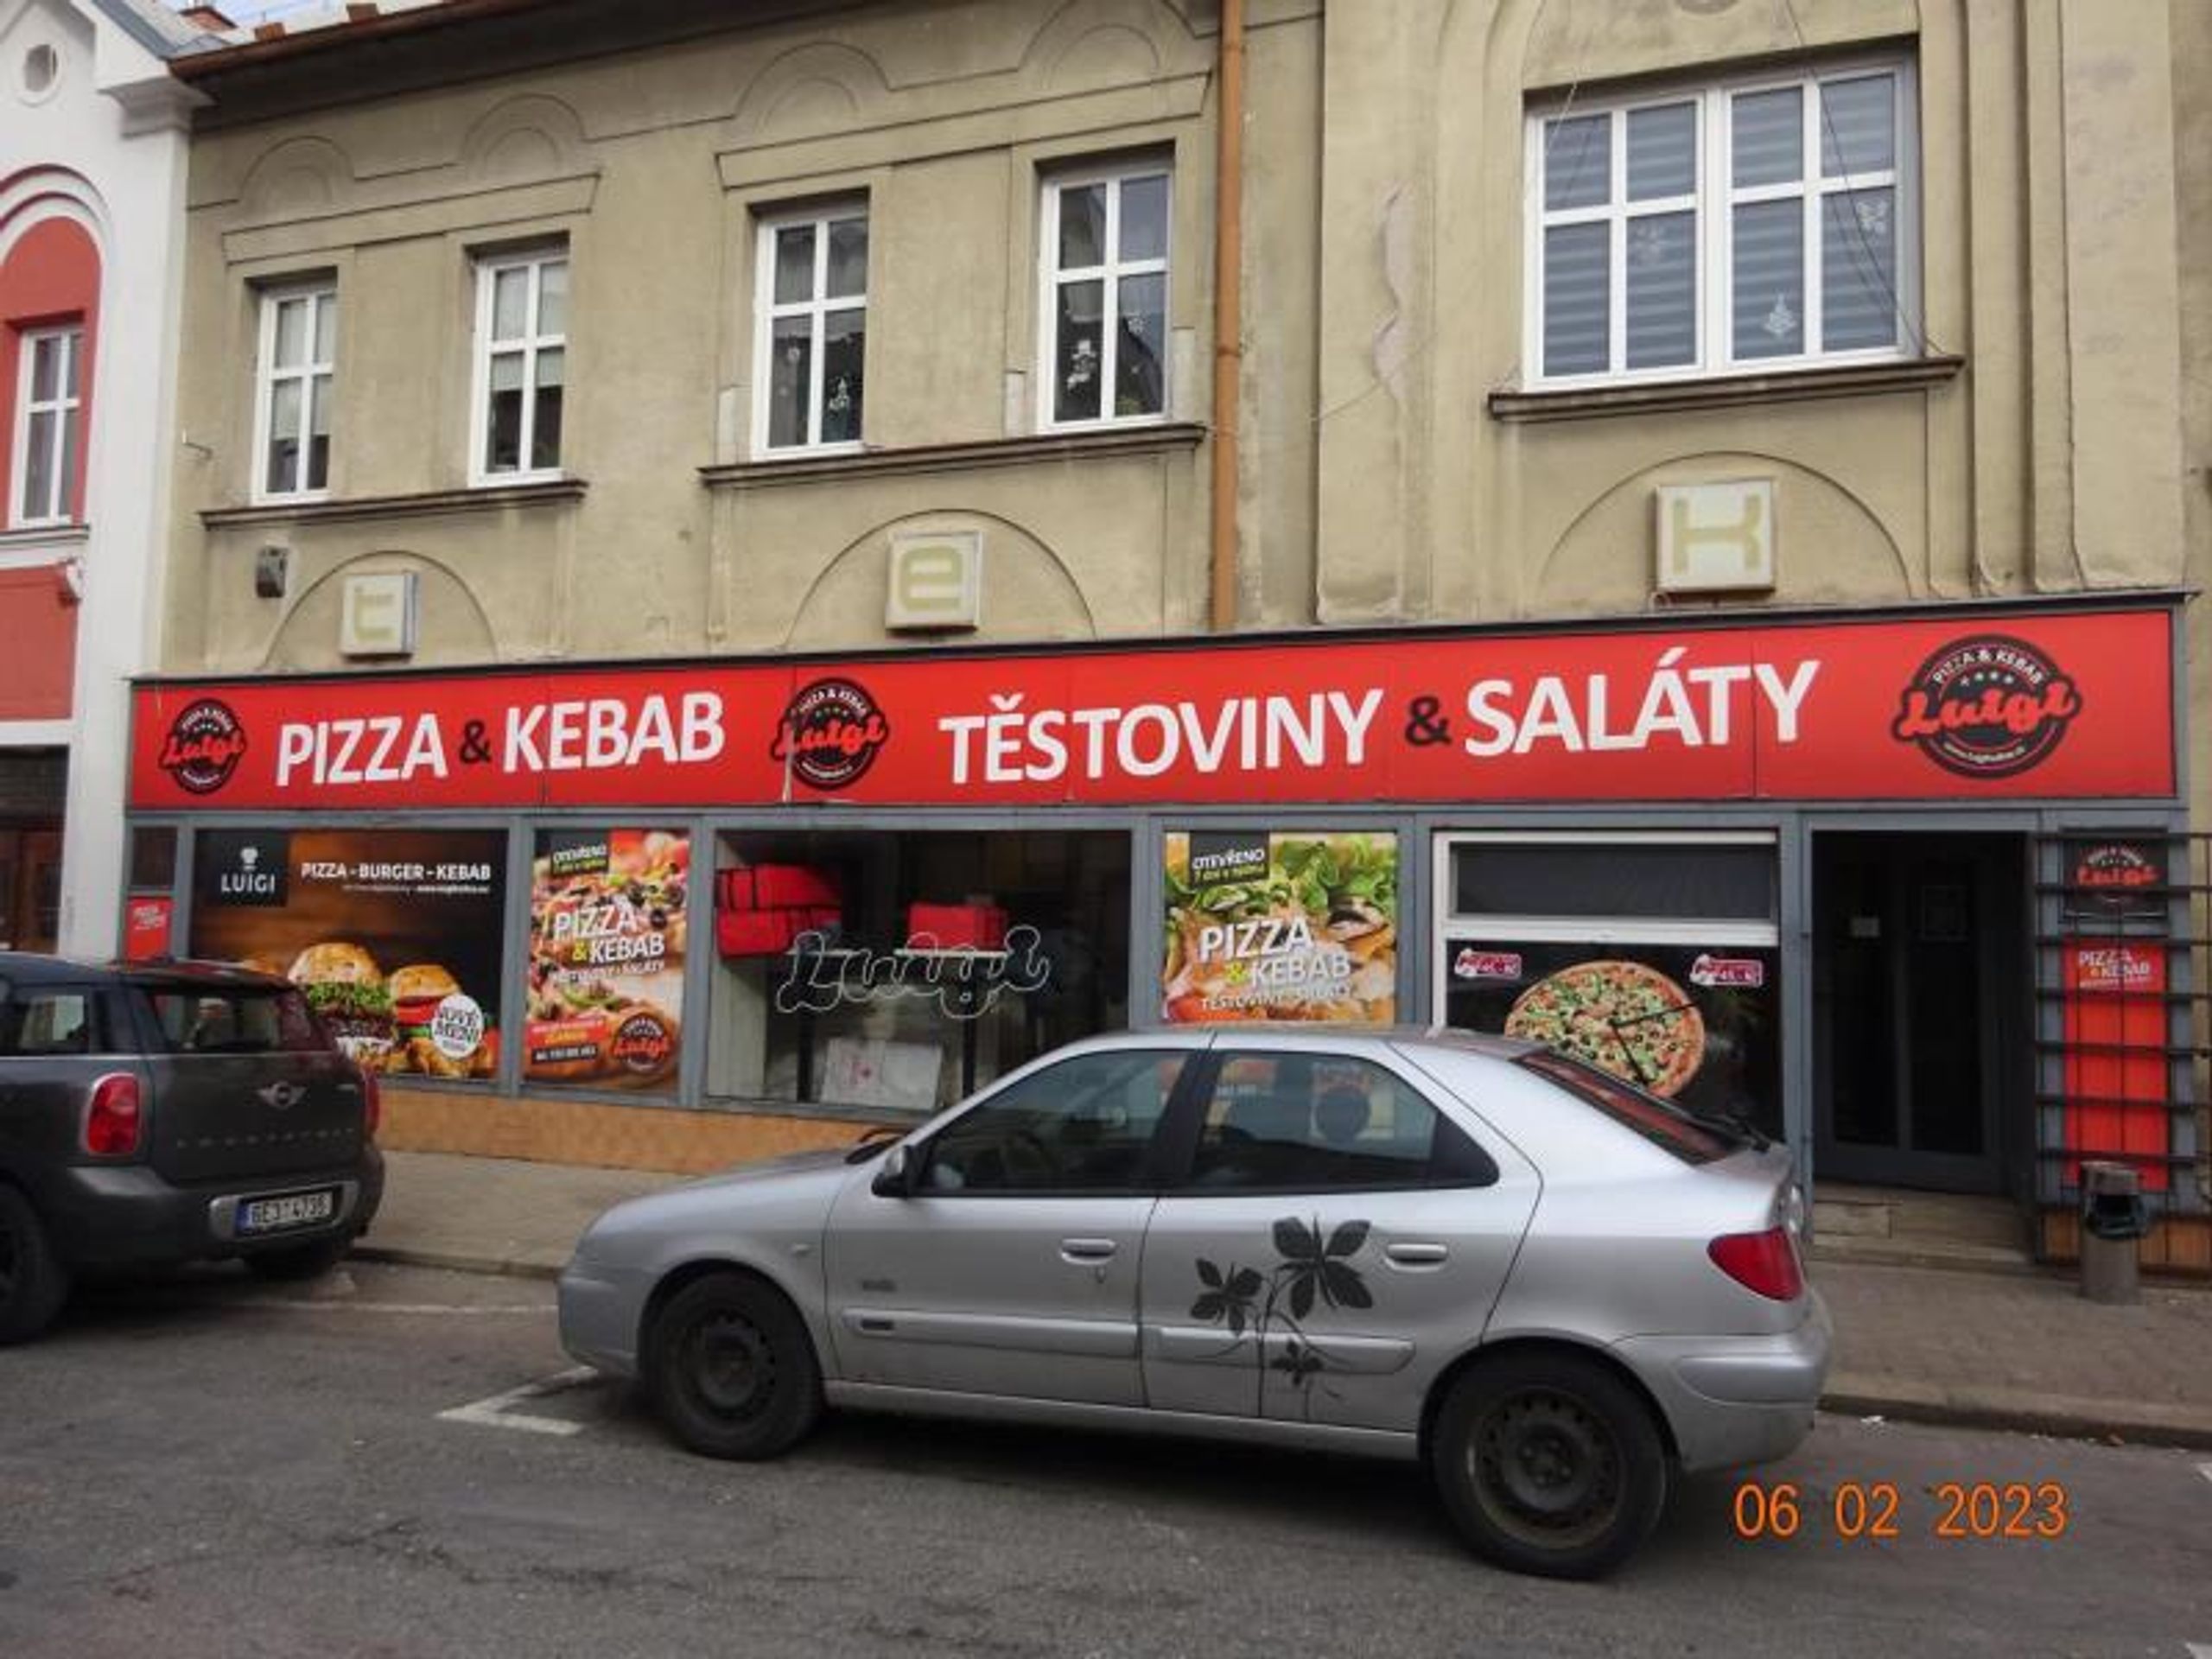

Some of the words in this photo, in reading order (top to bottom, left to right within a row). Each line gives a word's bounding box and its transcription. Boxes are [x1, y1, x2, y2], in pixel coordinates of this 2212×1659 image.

[938, 689, 1384, 784] TĚSTOVINY
[1404, 695, 1453, 747] &
[1465, 646, 1821, 757] SALÁTY
[276, 713, 449, 786] PIZZA
[459, 720, 492, 765] &
[503, 691, 726, 773] KEBAB
[221, 874, 276, 893] LUIGI
[302, 862, 346, 878] PIZZA
[359, 863, 423, 880] BURGER
[436, 863, 491, 880] KEBAB
[554, 893, 637, 940] PIZZA
[572, 938, 588, 961] &
[589, 932, 665, 963] KEBAB
[1199, 915, 1314, 964] PIZZA
[1225, 961, 1250, 985] &
[1251, 951, 1351, 987] KEBAB
